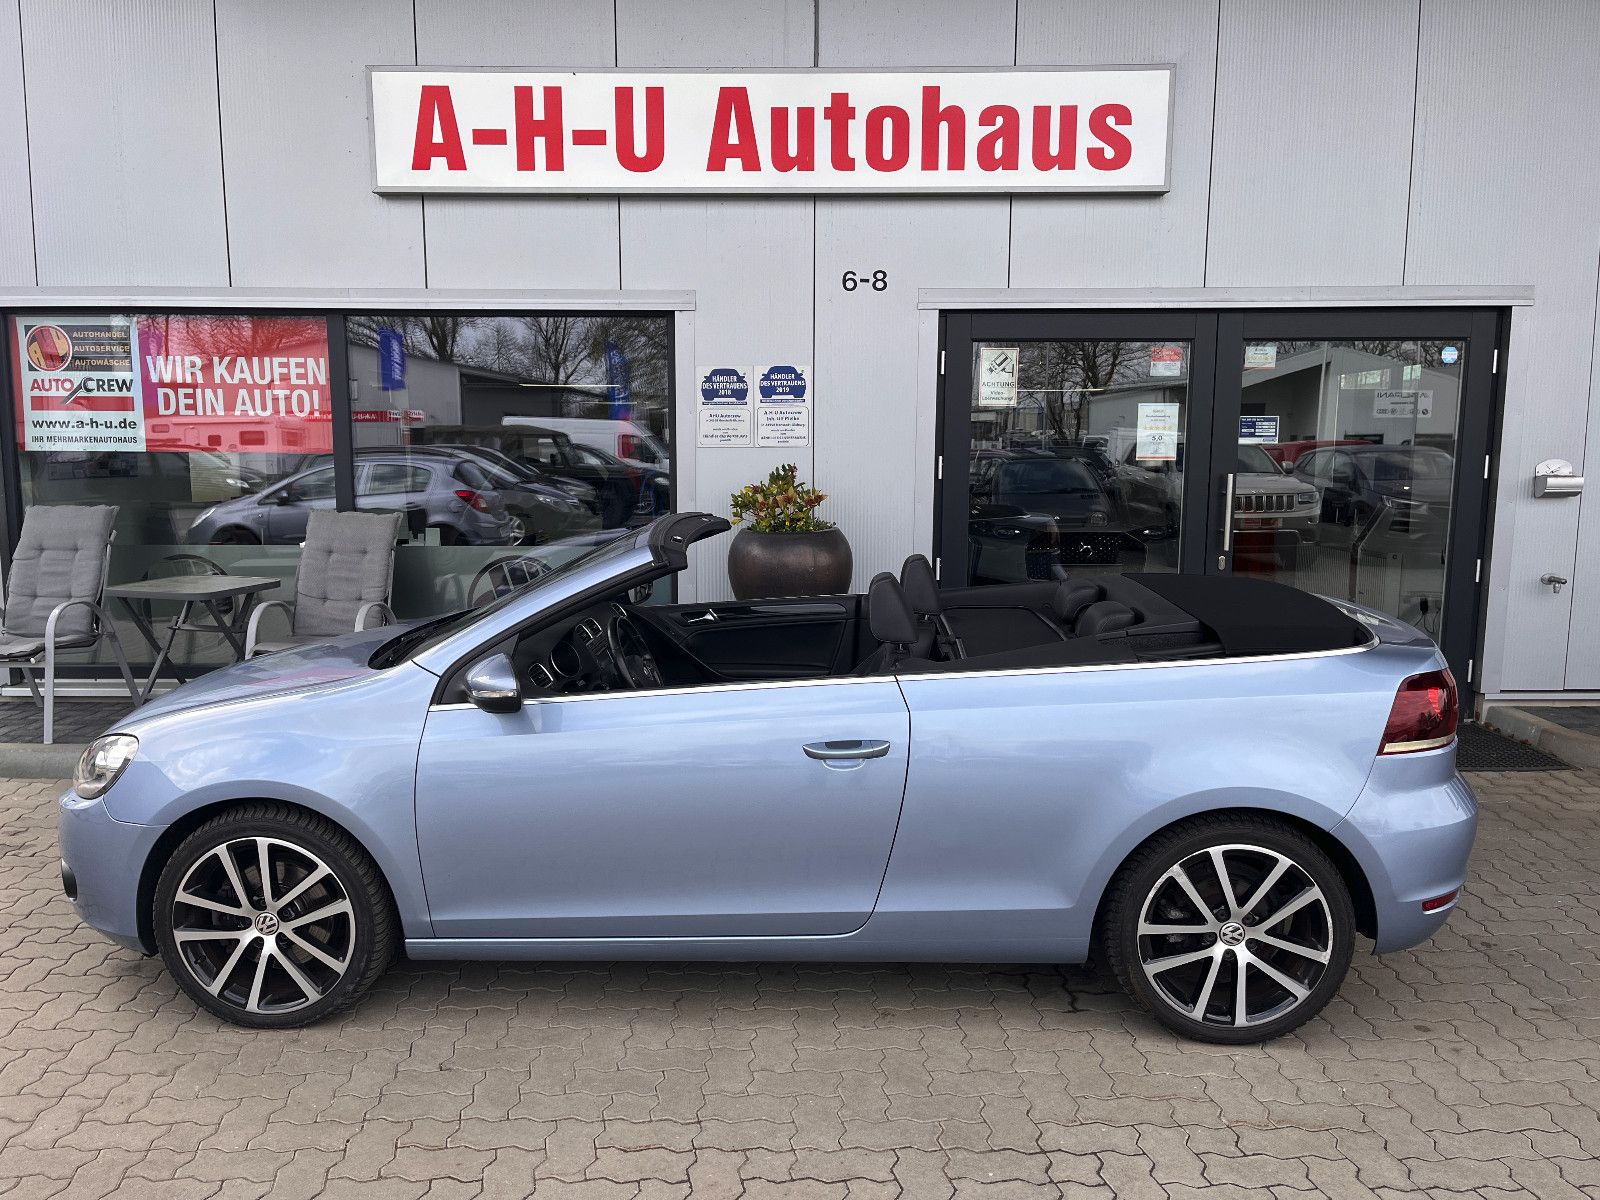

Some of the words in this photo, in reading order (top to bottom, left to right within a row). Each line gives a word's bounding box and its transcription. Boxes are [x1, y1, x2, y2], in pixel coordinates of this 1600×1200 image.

[411, 85, 665, 172] A-H-U
[706, 85, 1133, 173] Autohaus
[842, 270, 888, 292] 6-8
[146, 355, 205, 384] WIR
[213, 357, 327, 385] KAUFEN
[30, 378, 75, 392] AUTO
[82, 377, 133, 393] CREW
[775, 386, 790, 394] 2019
[158, 388, 224, 417] DEIN
[234, 388, 320, 418] AUTO!
[31, 418, 138, 430] www.a-h-u.de
[31, 435, 45, 443] IHR
[46, 435, 138, 444] MEHRMARKENAUTOHAUS
